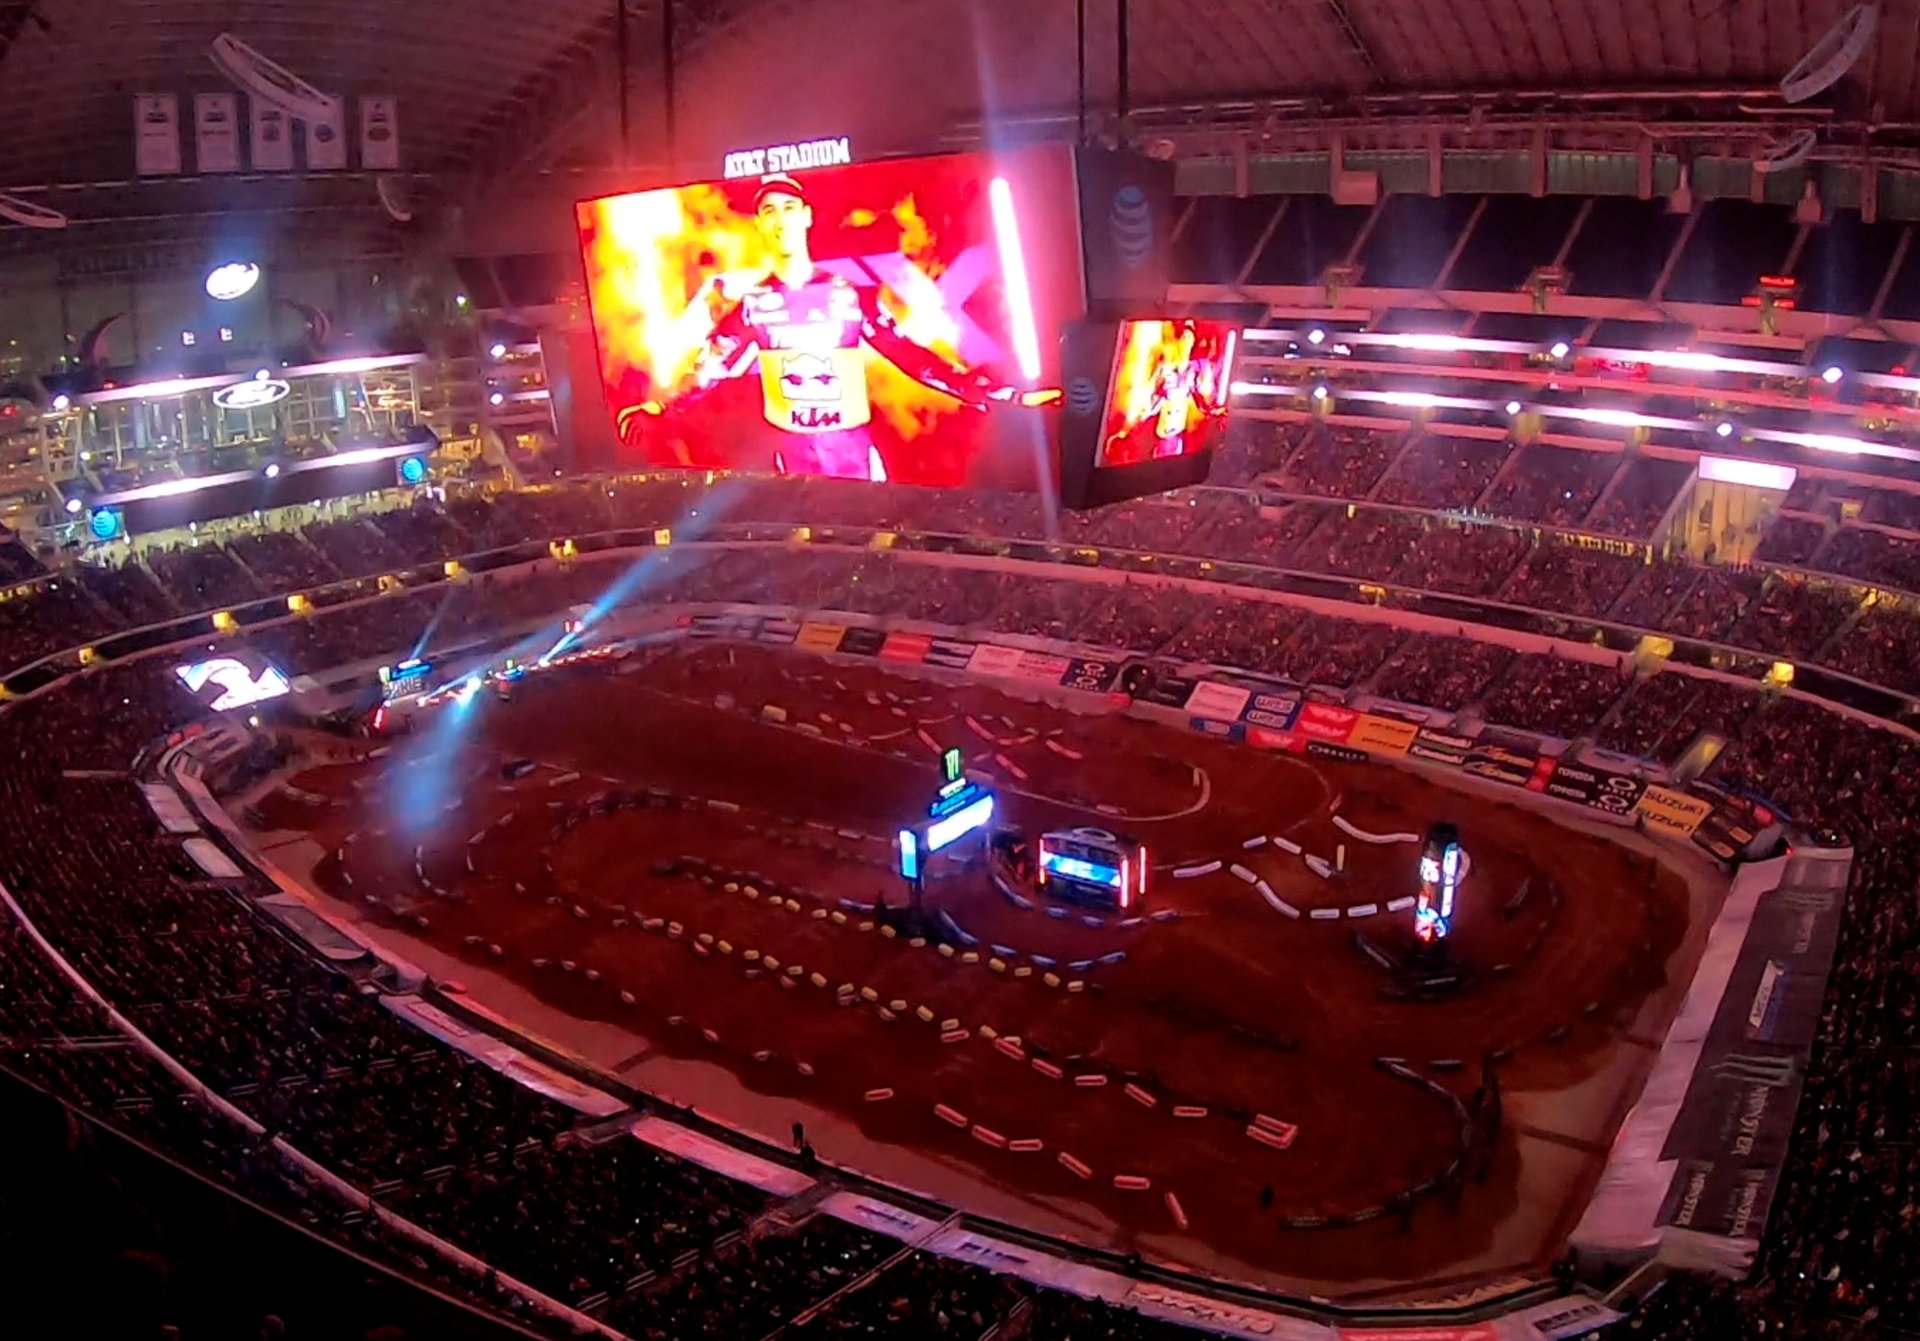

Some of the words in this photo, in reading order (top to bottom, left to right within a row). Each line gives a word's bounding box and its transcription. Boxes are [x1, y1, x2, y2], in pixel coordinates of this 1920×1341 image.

[724, 149, 766, 180] AT&T
[766, 136, 851, 173] STADIUM
[791, 407, 841, 428] KTM
[1549, 783, 1587, 800] TOYOTA
[1558, 766, 1596, 783] TOYOTA
[1643, 789, 1705, 815] SUZUKI
[1731, 1085, 1770, 1156] MONSTER
[1675, 1173, 1707, 1226] MONSTER
[1729, 1181, 1760, 1237] MONSTER
